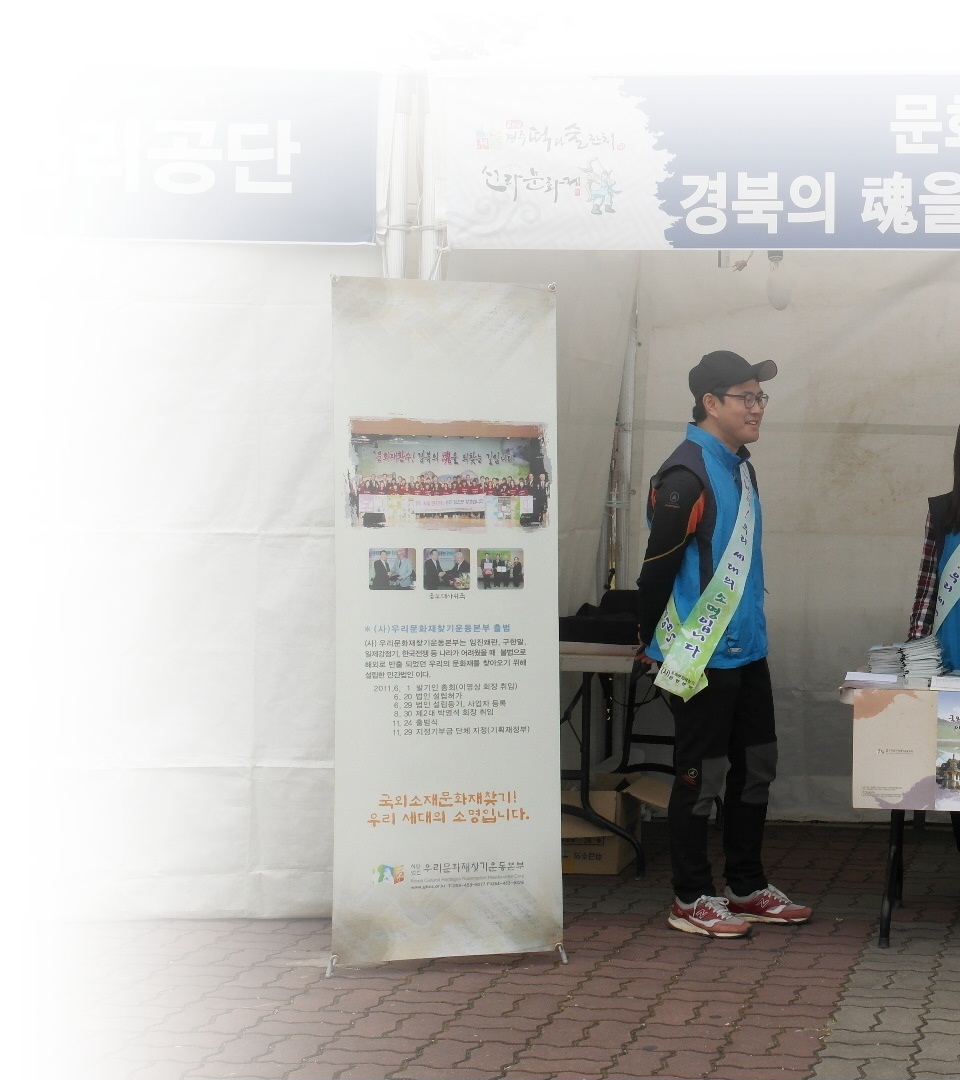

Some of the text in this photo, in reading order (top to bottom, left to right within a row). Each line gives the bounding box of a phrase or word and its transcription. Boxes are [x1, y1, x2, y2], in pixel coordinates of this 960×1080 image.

[680, 170, 835, 235] 경북의
[493, 623, 511, 633] 출범
[428, 660, 451, 668] 우리의
[378, 790, 517, 810] 국외소재문화재찾기!
[366, 812, 396, 828] 우리
[401, 810, 446, 825] 세대의
[422, 861, 524, 874] 우리문화재찾기운동본부
